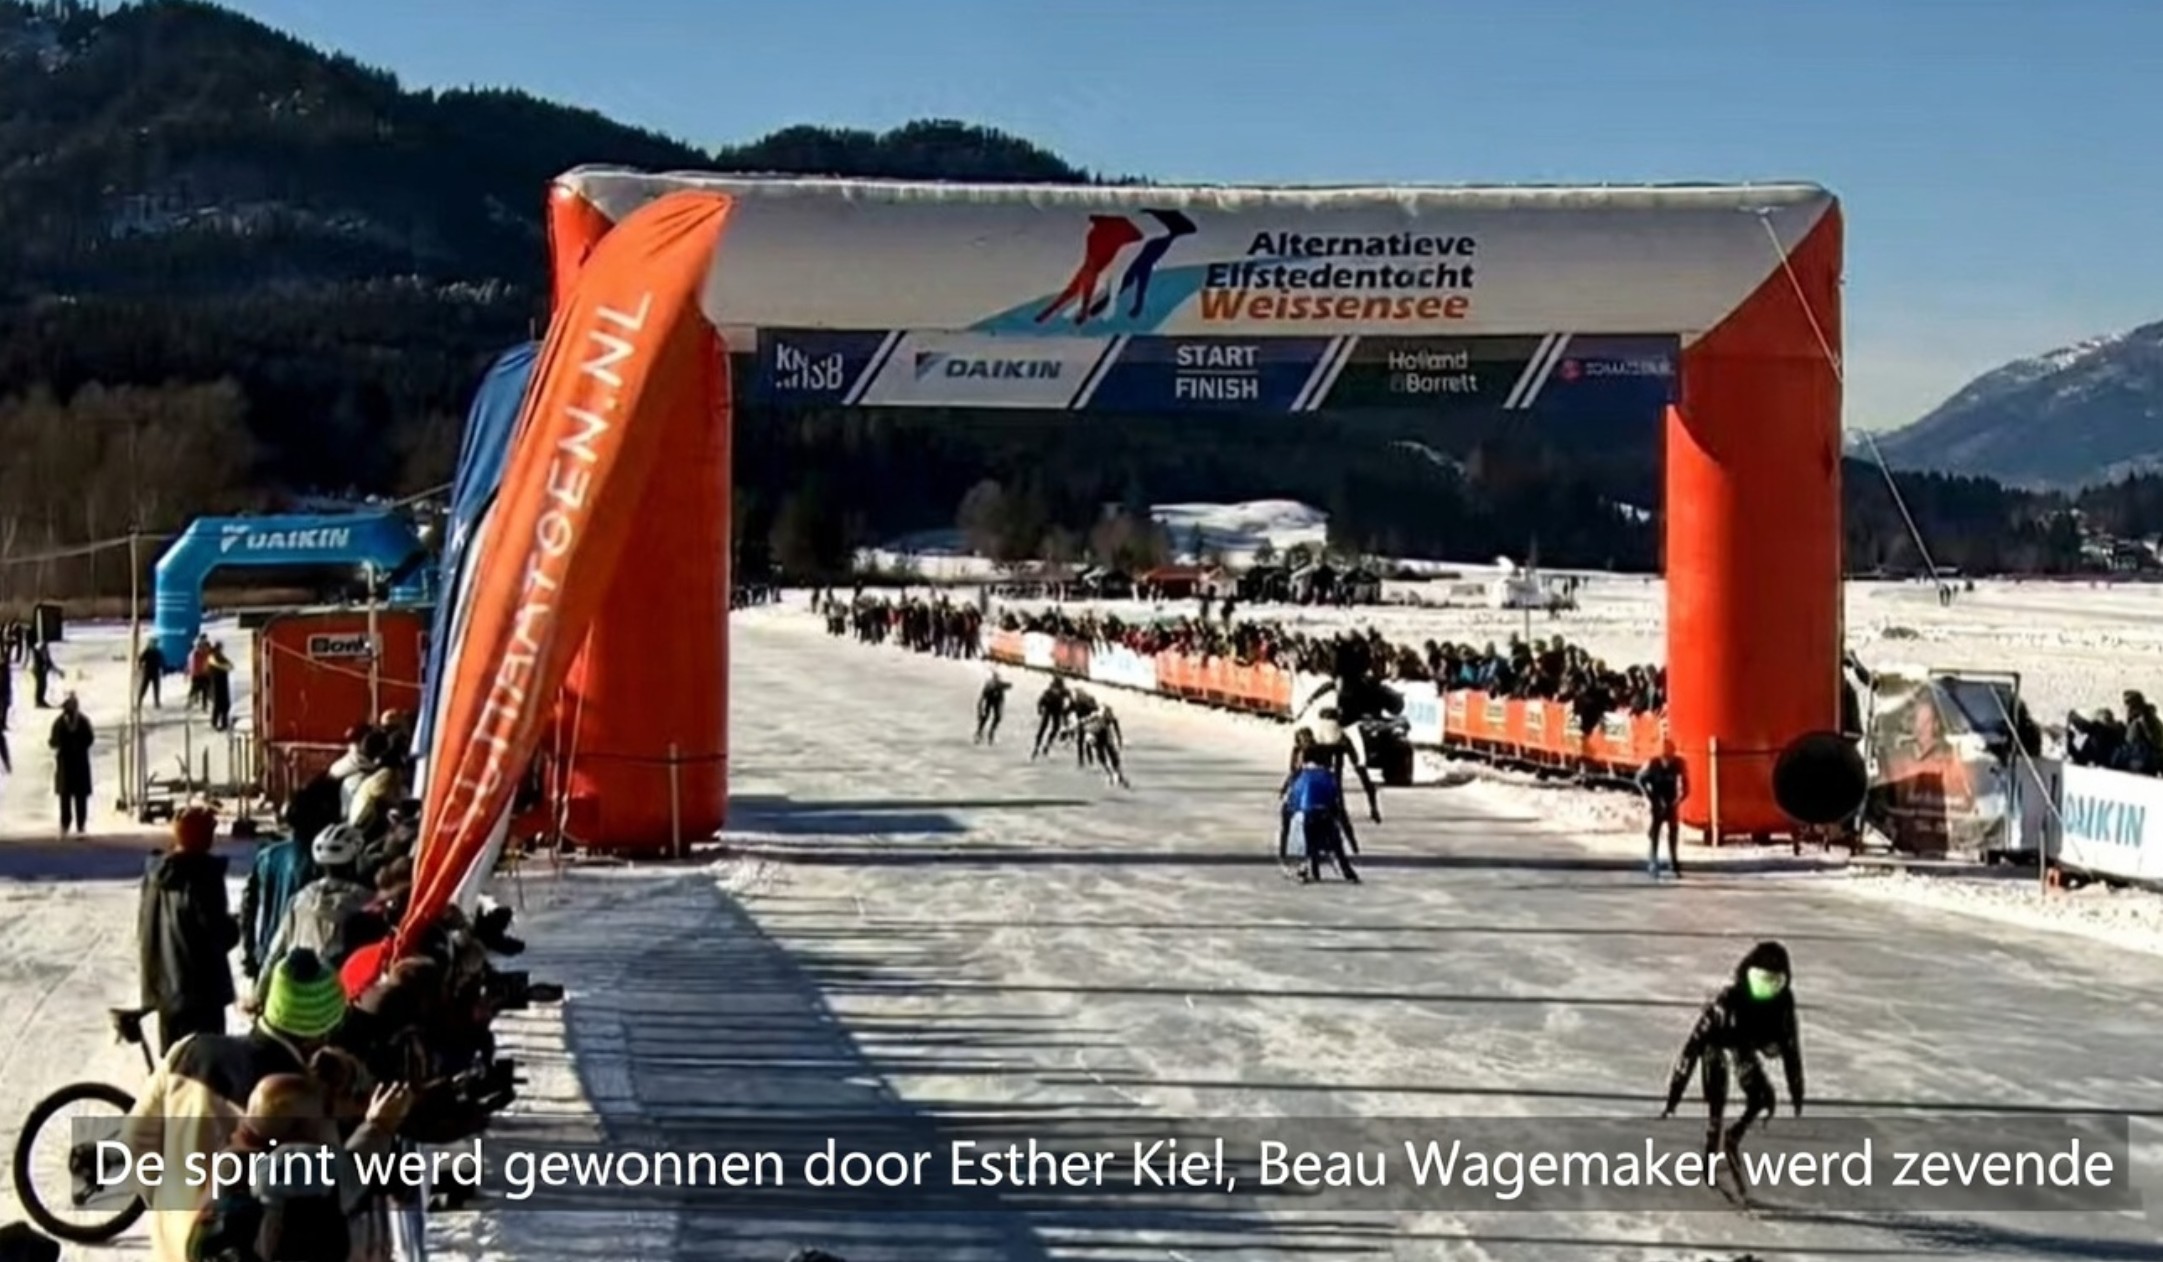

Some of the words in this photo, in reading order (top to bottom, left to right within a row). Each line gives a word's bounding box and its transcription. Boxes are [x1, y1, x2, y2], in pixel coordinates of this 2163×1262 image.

[1247, 231, 1477, 257] Alternatieve
[1205, 262, 1475, 289] Elfstedentocht
[1200, 288, 1470, 321] Weissensee
[1176, 346, 1259, 367] START
[944, 359, 1063, 379] DAIKIN
[1175, 377, 1260, 400] FINISH
